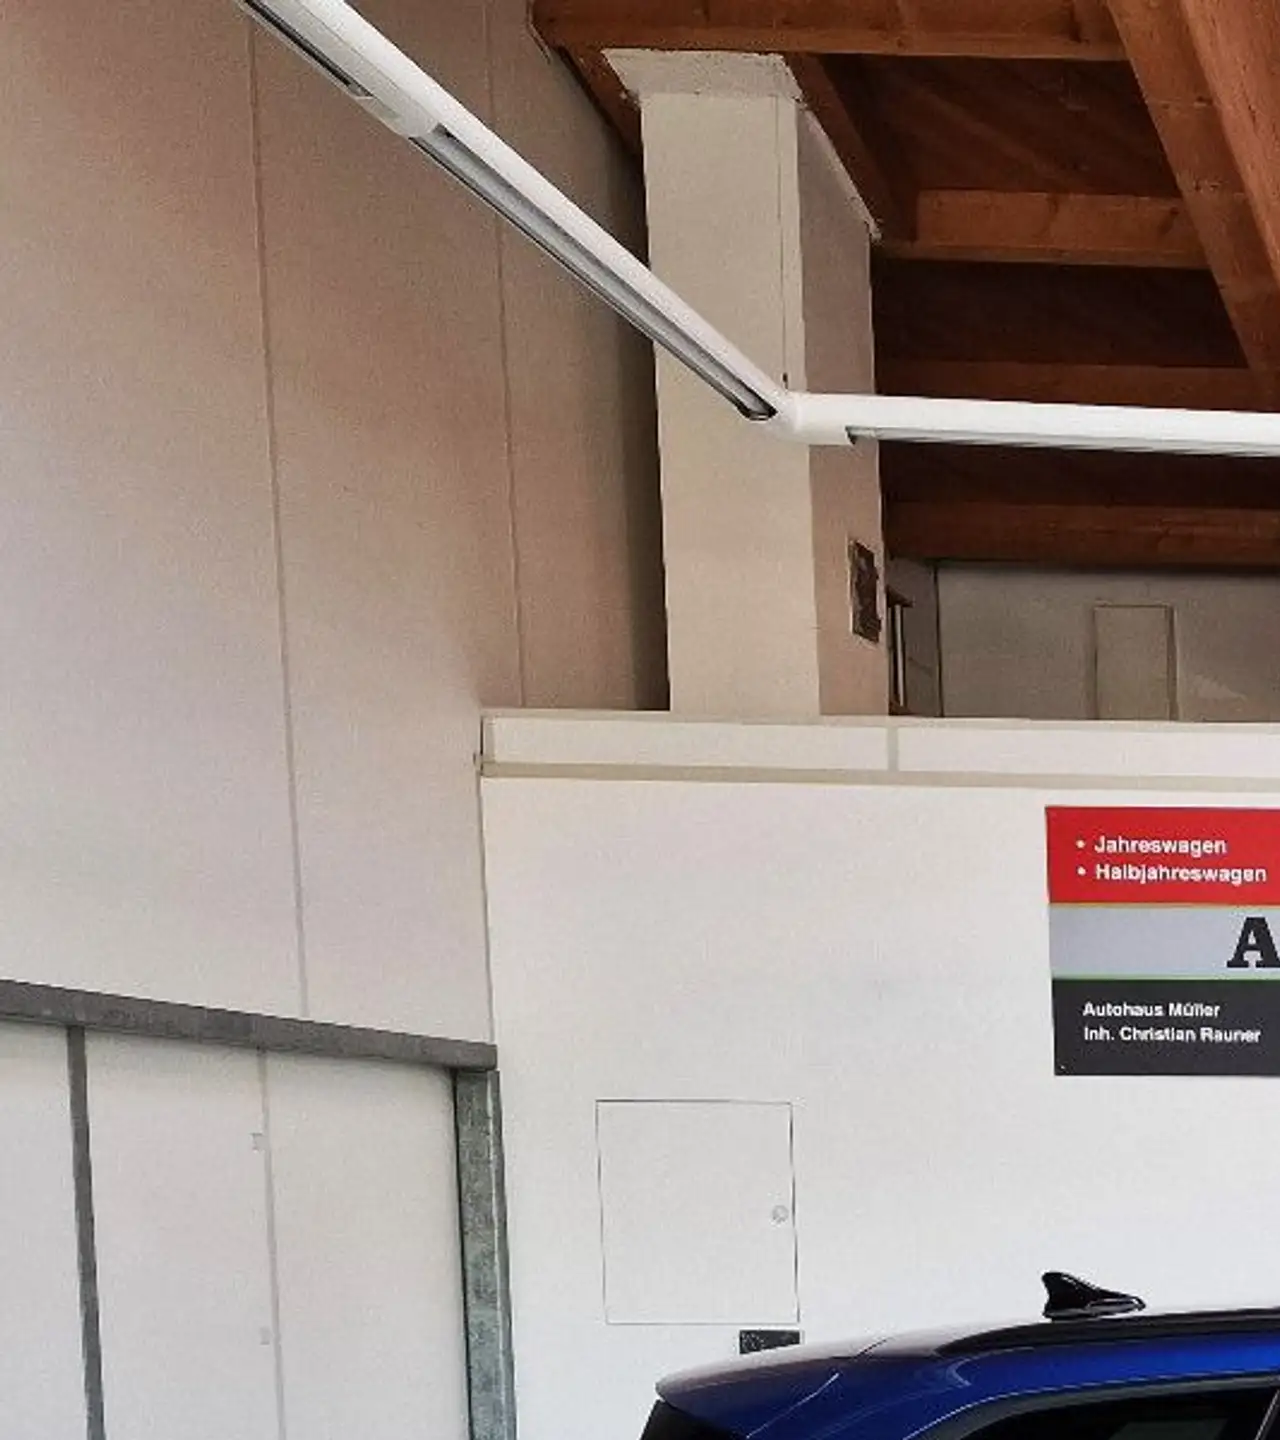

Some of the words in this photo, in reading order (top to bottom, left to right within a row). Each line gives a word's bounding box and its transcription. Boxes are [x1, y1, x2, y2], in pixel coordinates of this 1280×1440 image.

[1094, 836, 1228, 858] Jahreswagen
[1095, 864, 1267, 888] Halbjahreswagen
[1083, 1002, 1164, 1017] Autohaus
[1168, 1002, 1221, 1018] Müller
[1084, 1026, 1114, 1041] Inh.
[1119, 1026, 1196, 1042] Christian
[1200, 1027, 1261, 1043] Rauner
